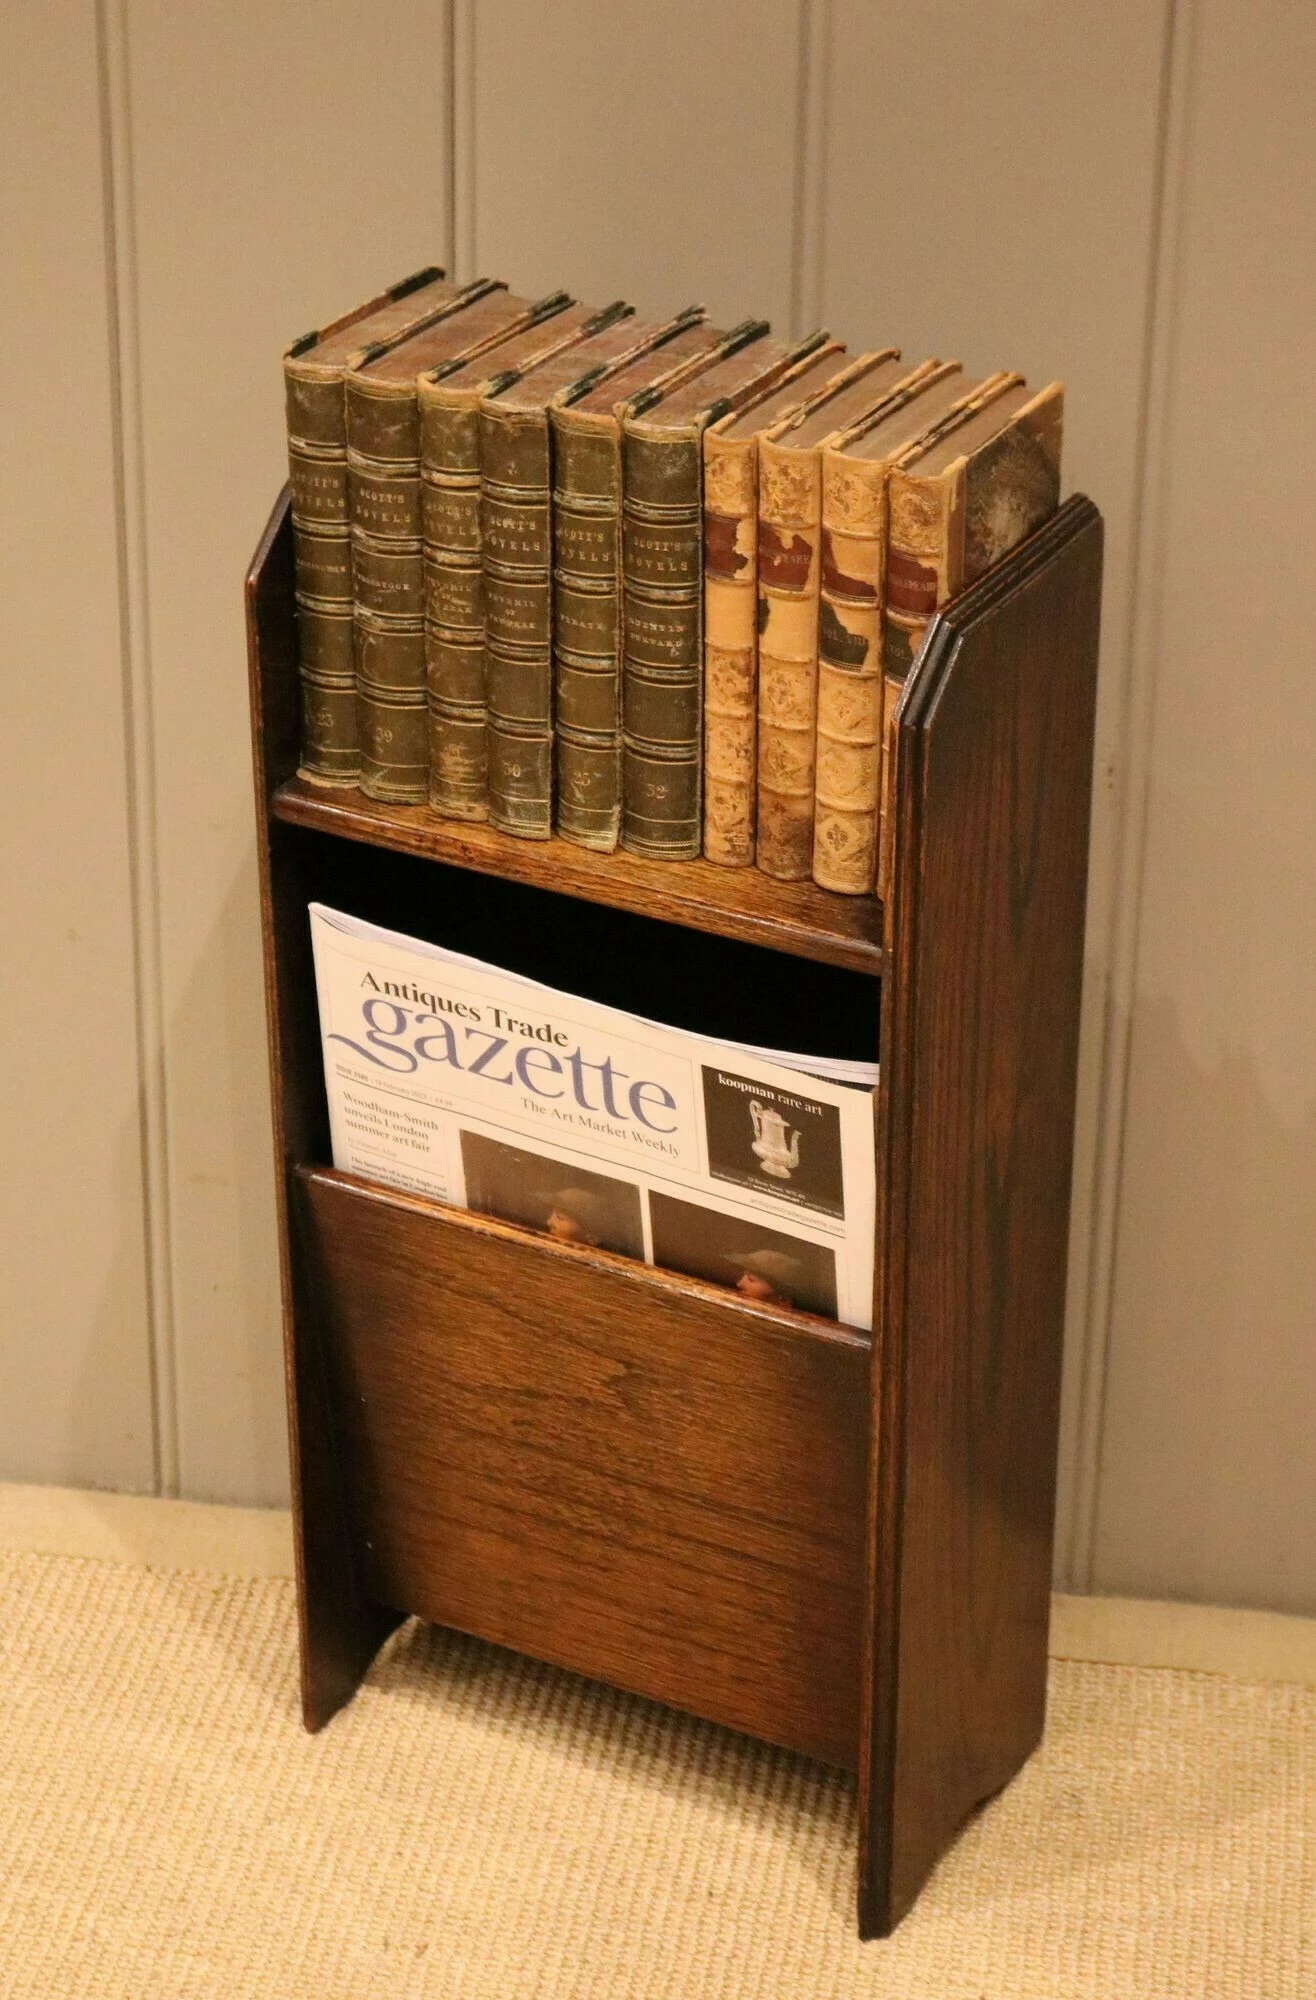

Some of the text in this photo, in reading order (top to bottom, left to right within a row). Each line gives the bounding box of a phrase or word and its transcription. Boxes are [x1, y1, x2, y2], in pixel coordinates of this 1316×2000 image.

[355, 504, 412, 523] NOVELS
[360, 488, 405, 504] SCOTT'S
[633, 536, 681, 552] SCOTT'S
[361, 972, 569, 1047] Antiques Trade
[327, 999, 679, 1134] gazette
[343, 1091, 439, 1131] Woodham-Smith
[718, 1073, 823, 1117] koopman rare art
[344, 1106, 429, 1141] unveils London
[345, 1119, 389, 1140] summer
[392, 1134, 409, 1146] art
[411, 1140, 431, 1153] fair
[521, 1097, 680, 1159] The Art Market Weekly
